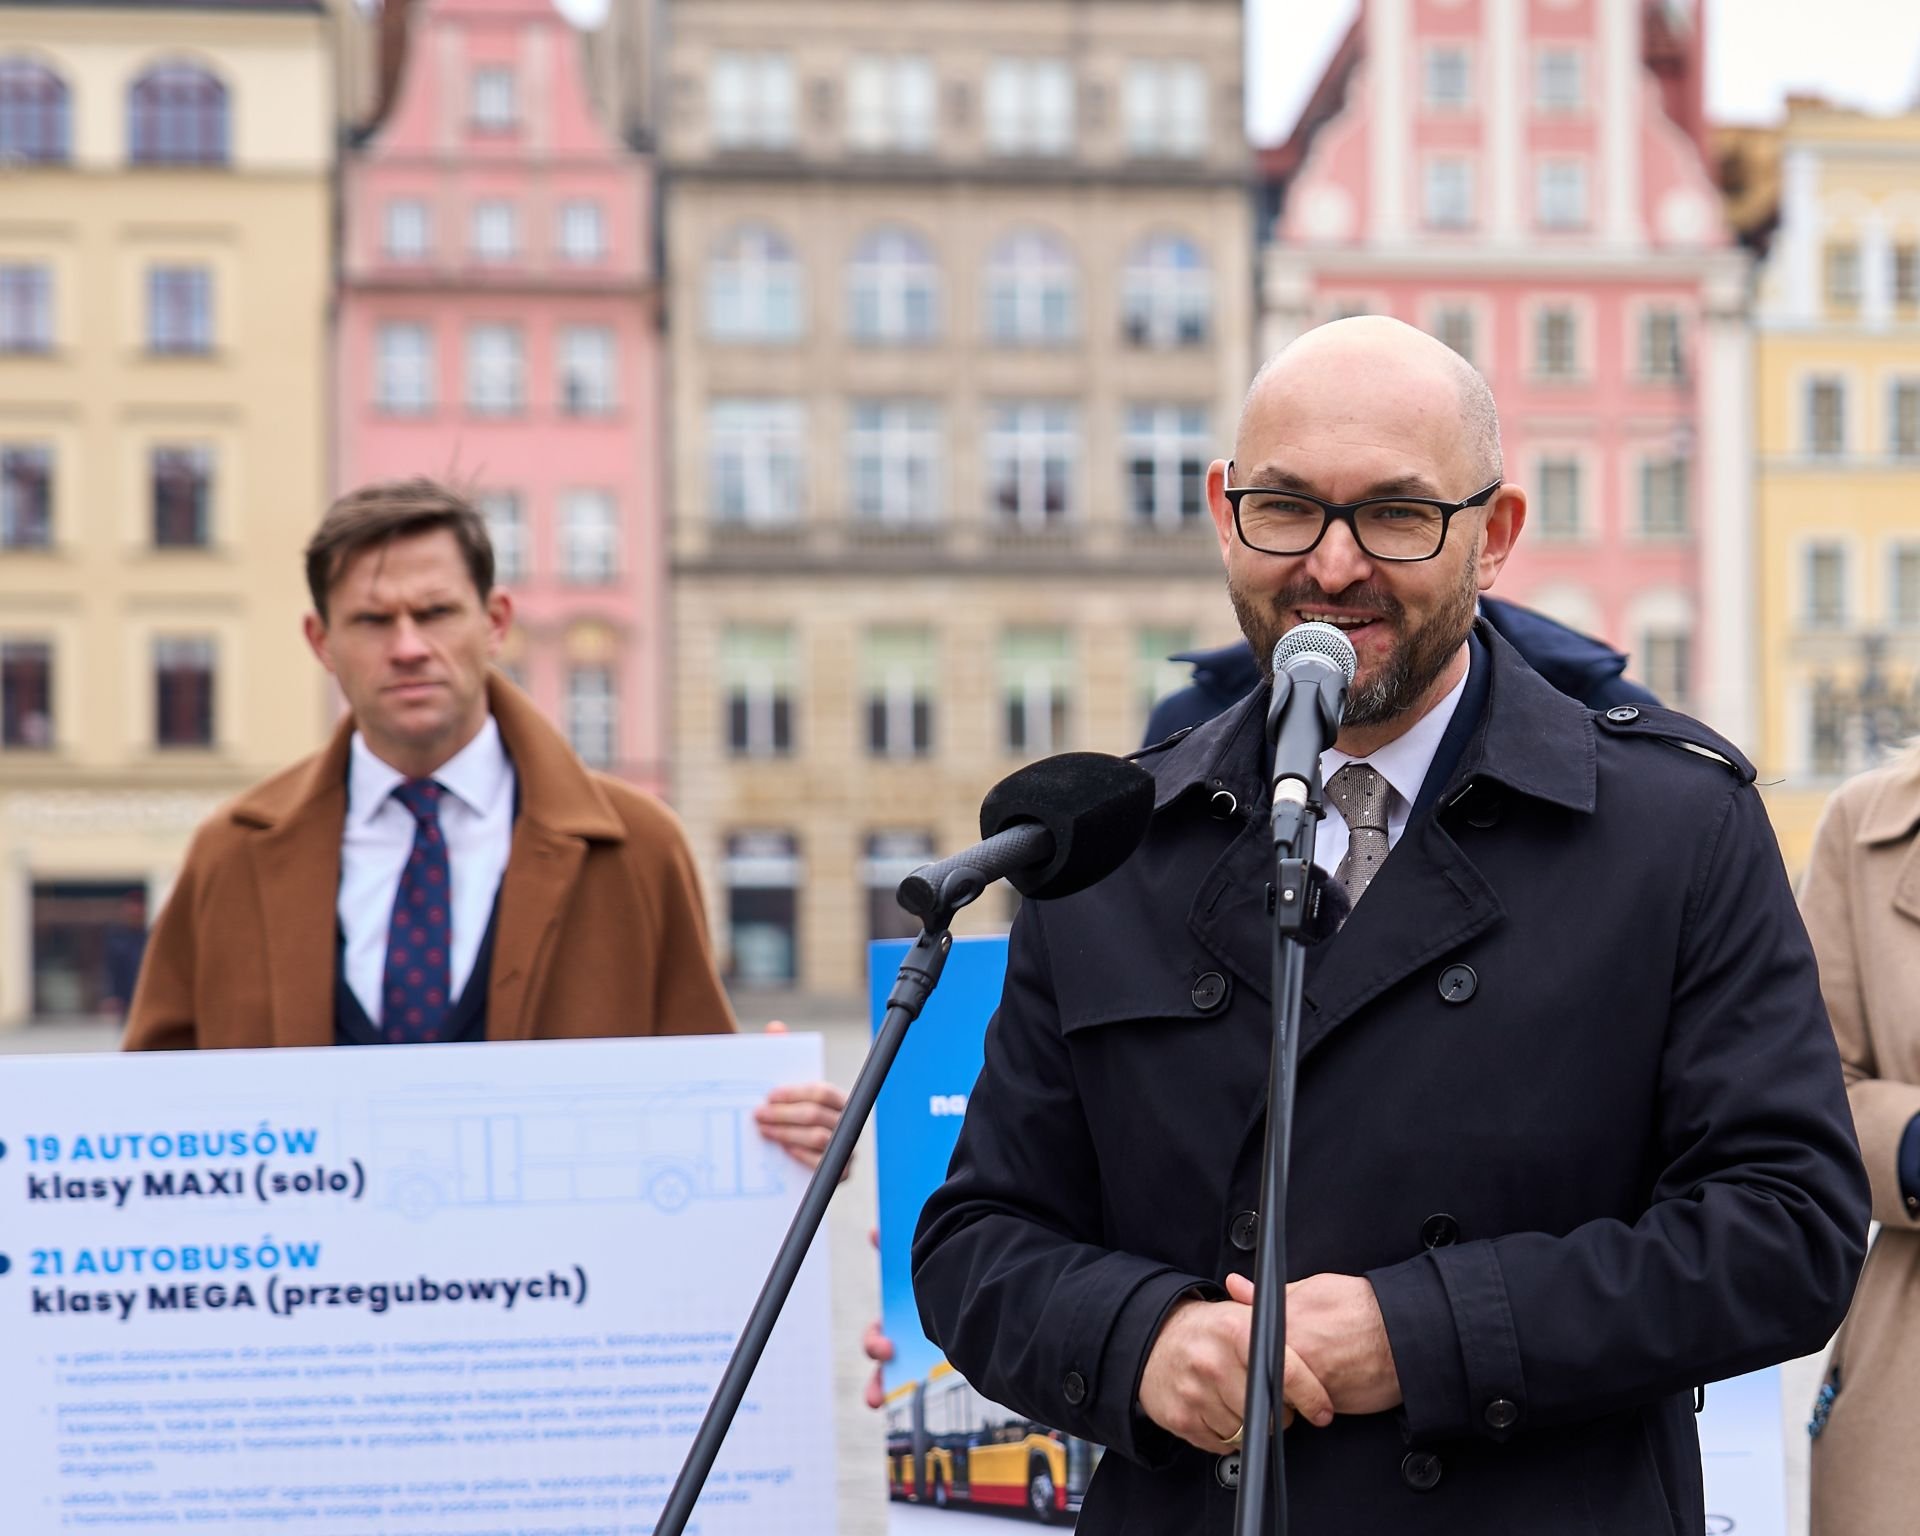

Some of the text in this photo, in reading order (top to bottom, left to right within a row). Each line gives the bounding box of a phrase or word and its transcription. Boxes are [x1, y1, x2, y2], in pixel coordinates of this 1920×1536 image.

[25, 1120, 318, 1162] 19 AUTOBUSÓW
[28, 1158, 365, 1208] klasy MAXI (solo)
[31, 1234, 320, 1275] 21 AUTOBUSÓW
[32, 1265, 588, 1321] klasy MEGA (przegubowych)
